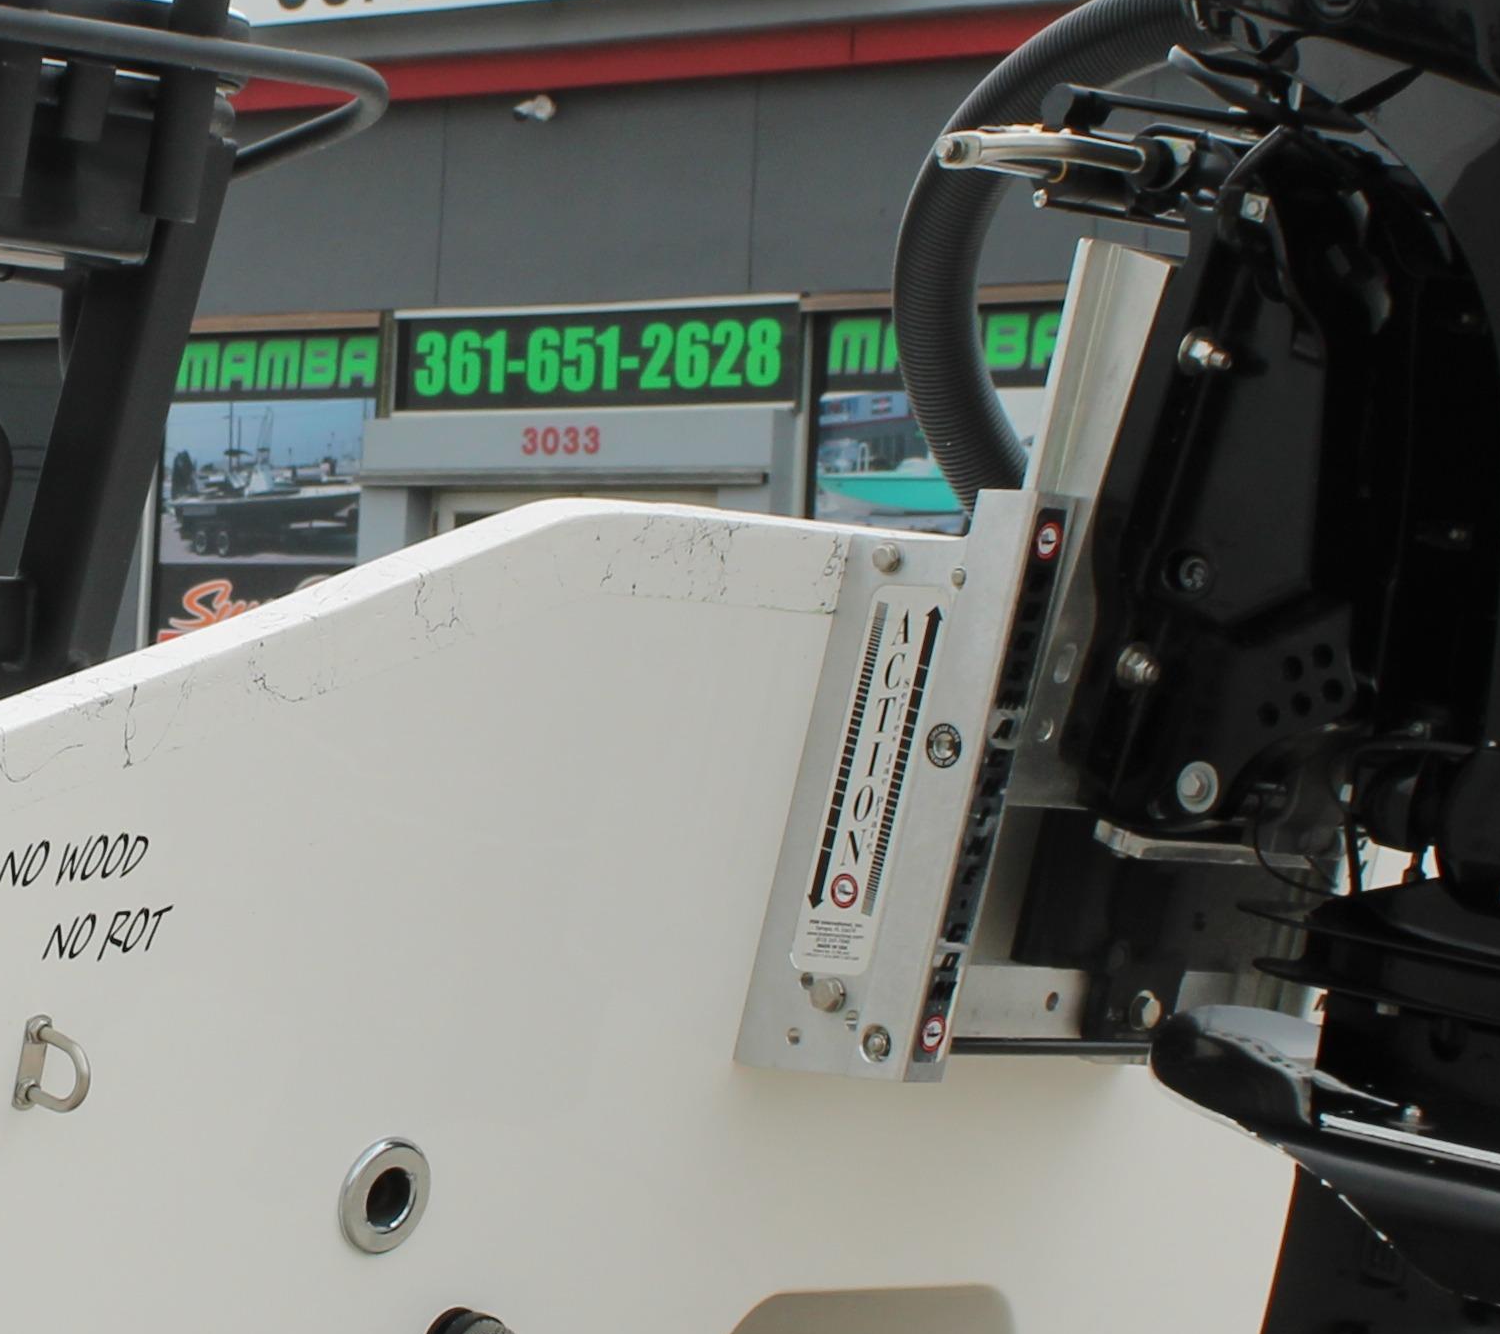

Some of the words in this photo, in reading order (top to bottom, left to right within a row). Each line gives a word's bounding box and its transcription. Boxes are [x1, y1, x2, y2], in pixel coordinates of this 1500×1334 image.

[175, 337, 380, 391] MAMBA
[414, 316, 783, 398] 361-651-2628
[521, 425, 601, 457] 3033
[55, 832, 149, 886] WOOD
[42, 913, 97, 961] NO
[97, 905, 174, 962] ROT
